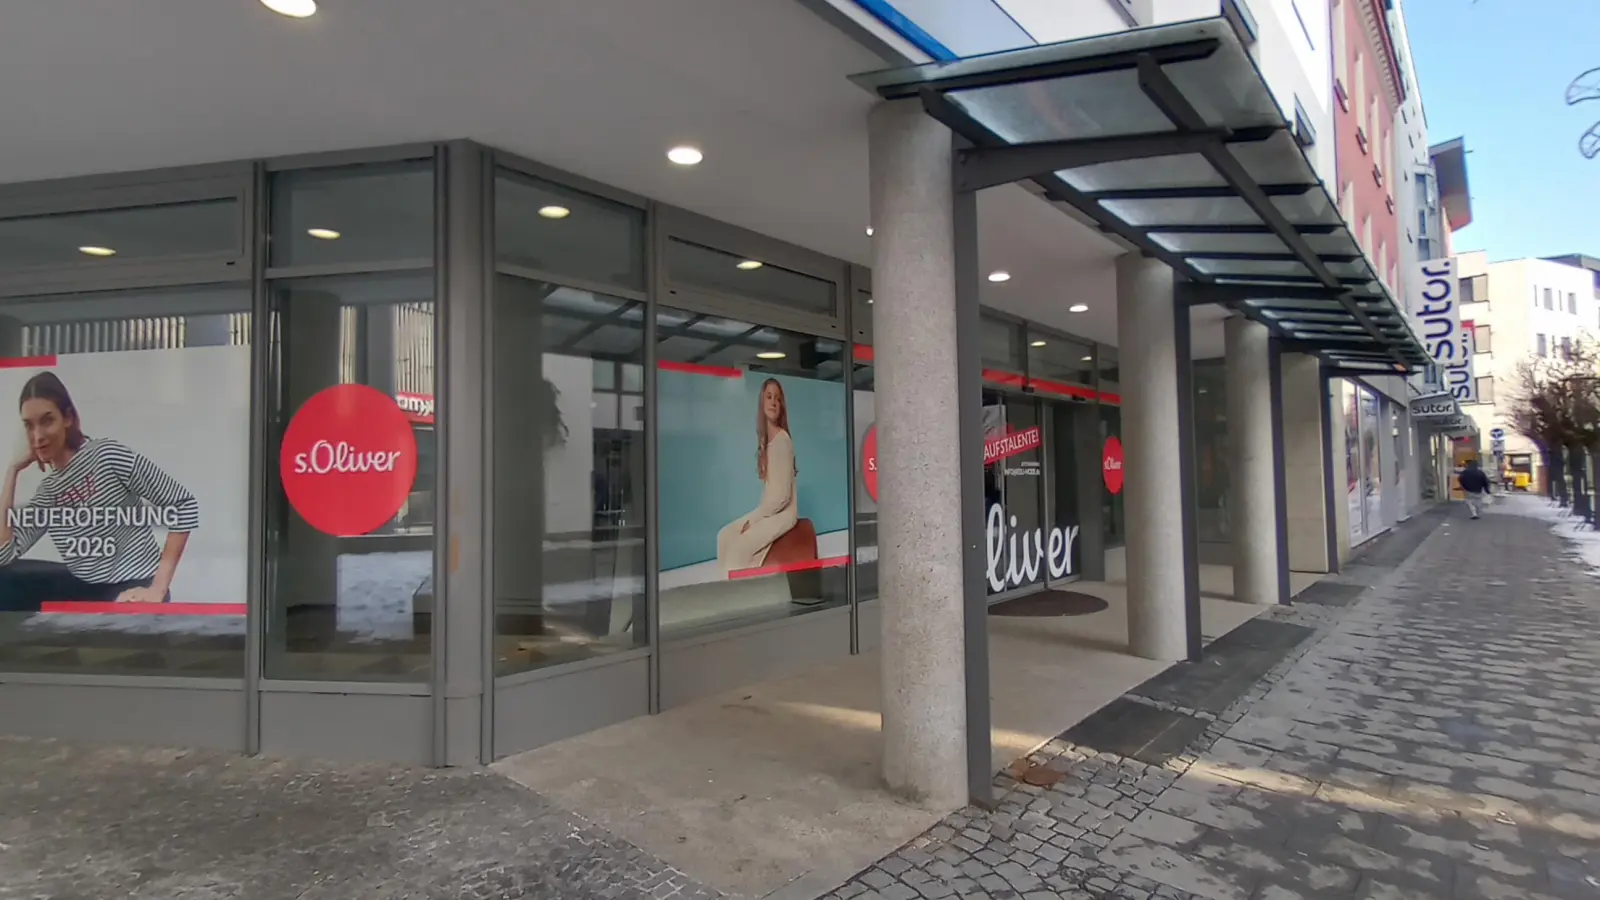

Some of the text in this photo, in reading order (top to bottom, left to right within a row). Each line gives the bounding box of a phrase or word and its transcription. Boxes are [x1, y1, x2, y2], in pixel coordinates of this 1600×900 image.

[1416, 261, 1454, 359] sutor.
[294, 440, 401, 474] s.Oliver
[983, 429, 1040, 460] AUFSTALENTE!
[6, 503, 179, 527] NEUERÖFFNUNG
[66, 537, 116, 556] 2026
[985, 503, 1080, 592] liver
